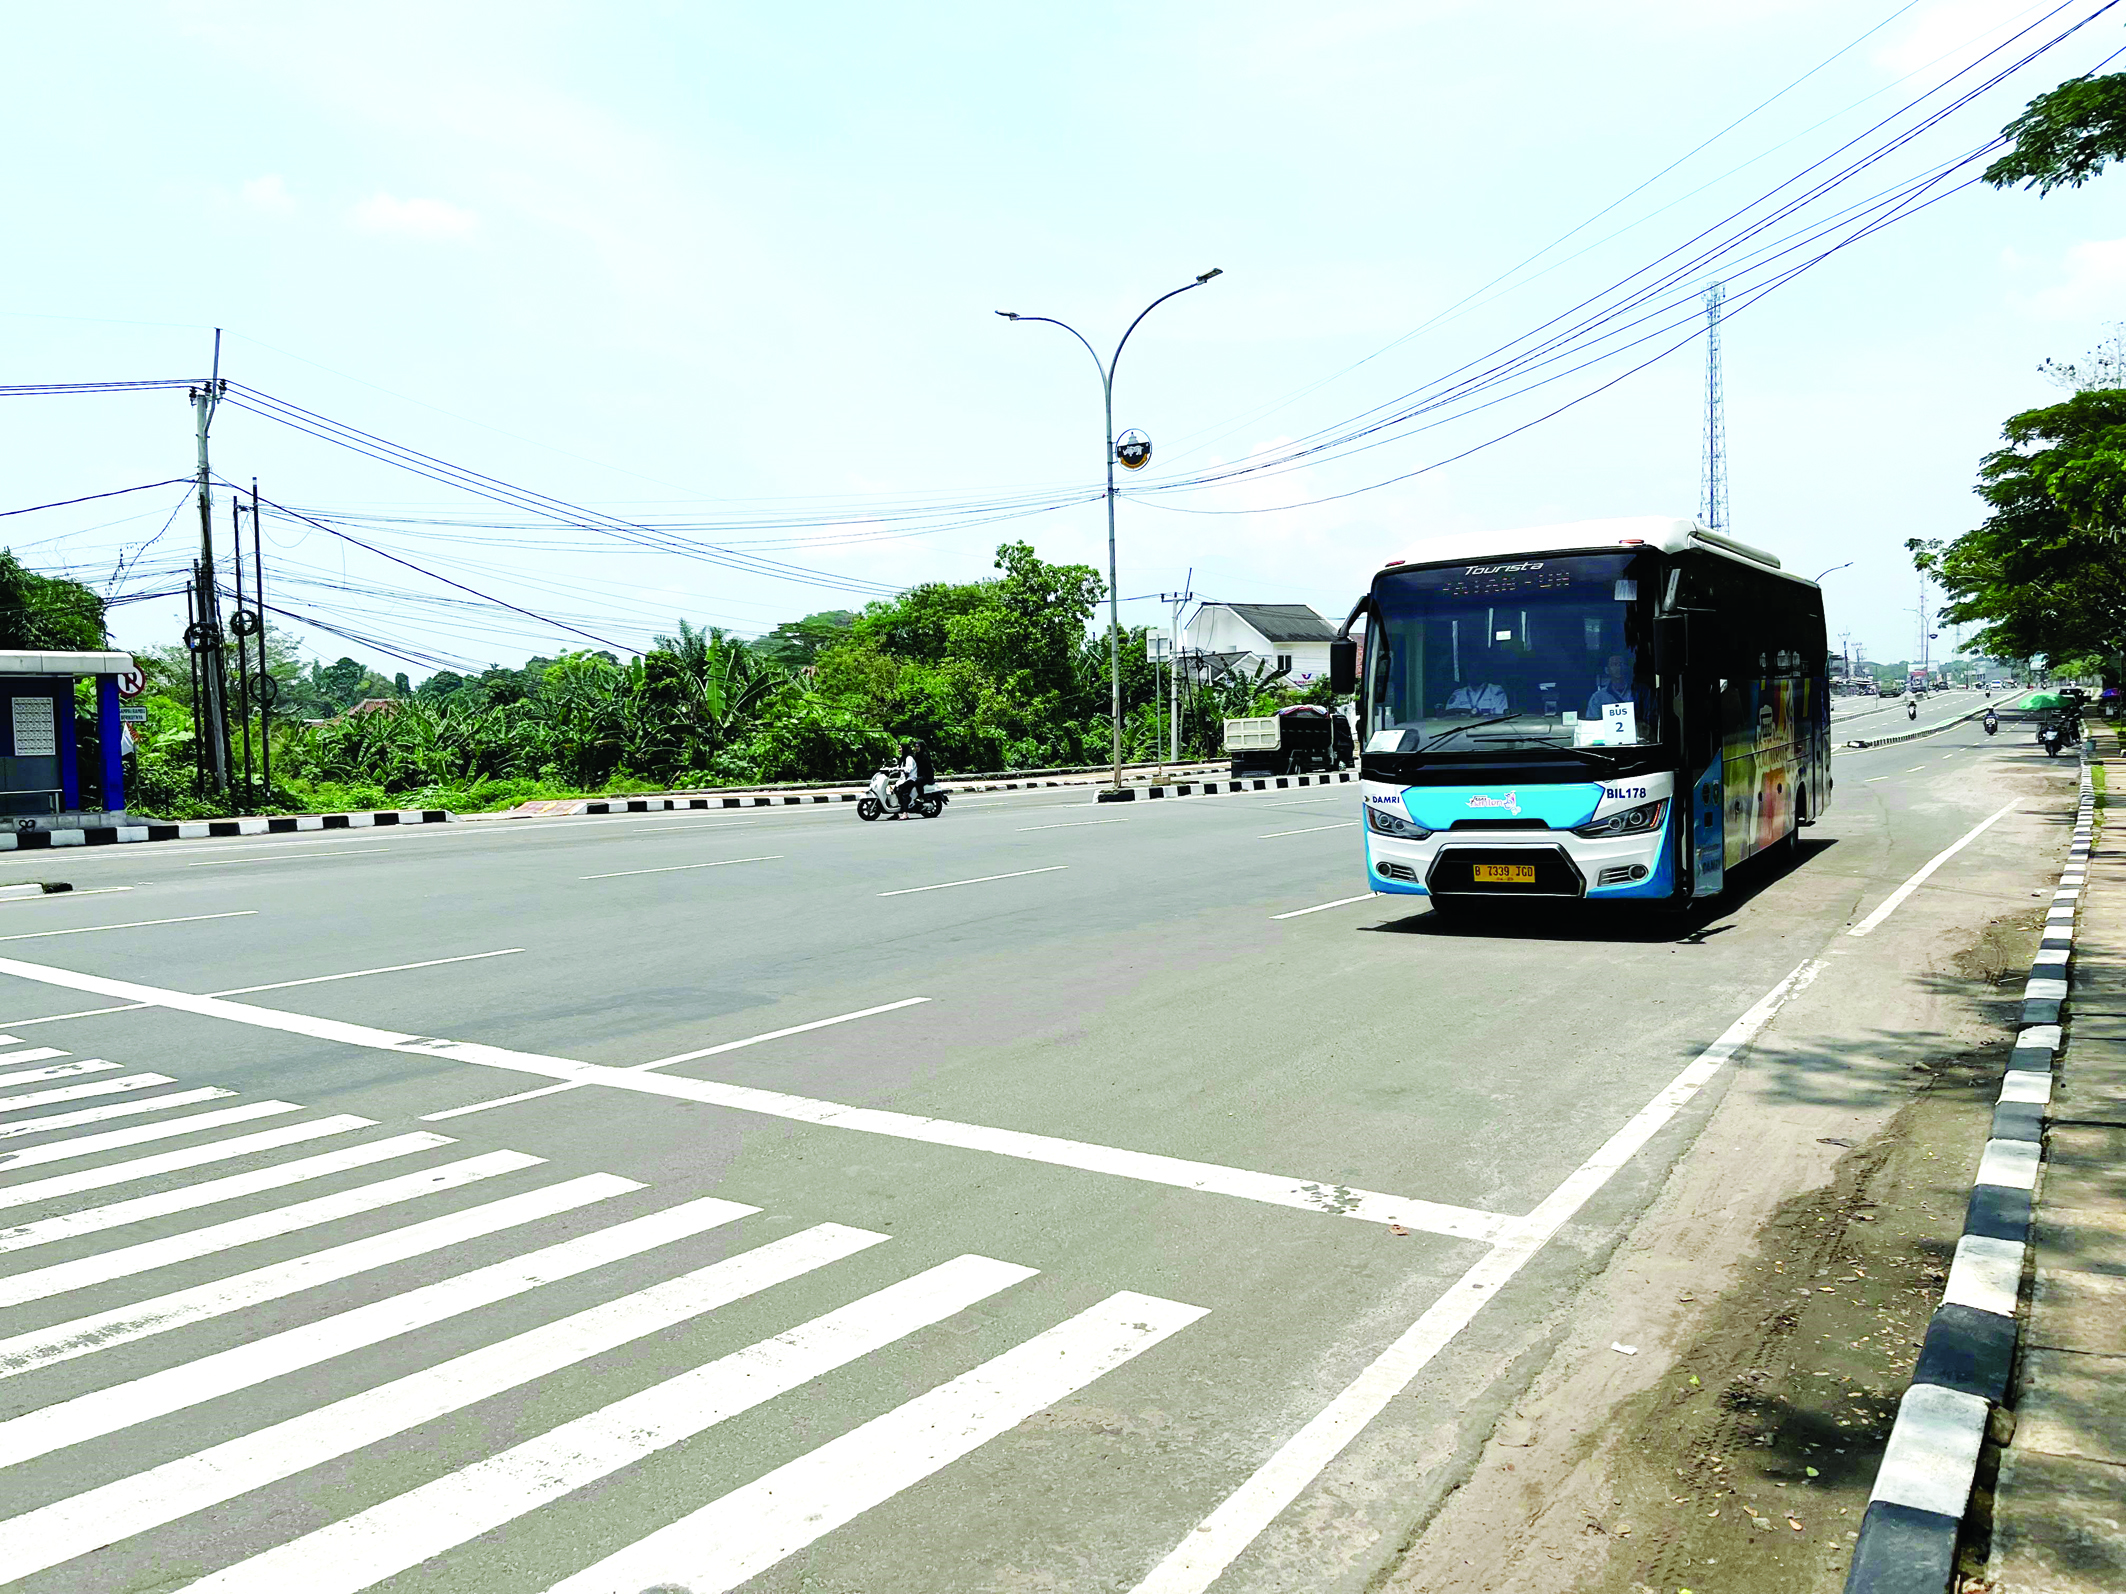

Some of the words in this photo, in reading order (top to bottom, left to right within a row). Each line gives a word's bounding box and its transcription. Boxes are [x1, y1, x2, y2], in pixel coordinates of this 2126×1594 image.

[1465, 562, 1544, 576] Tourista
[1609, 708, 1628, 717] BUS
[1615, 721, 1624, 732] 2
[1606, 787, 1647, 799] BIL178
[1372, 795, 1400, 804] DAMRI
[1475, 865, 1481, 876] B
[1487, 865, 1510, 876] 7339
